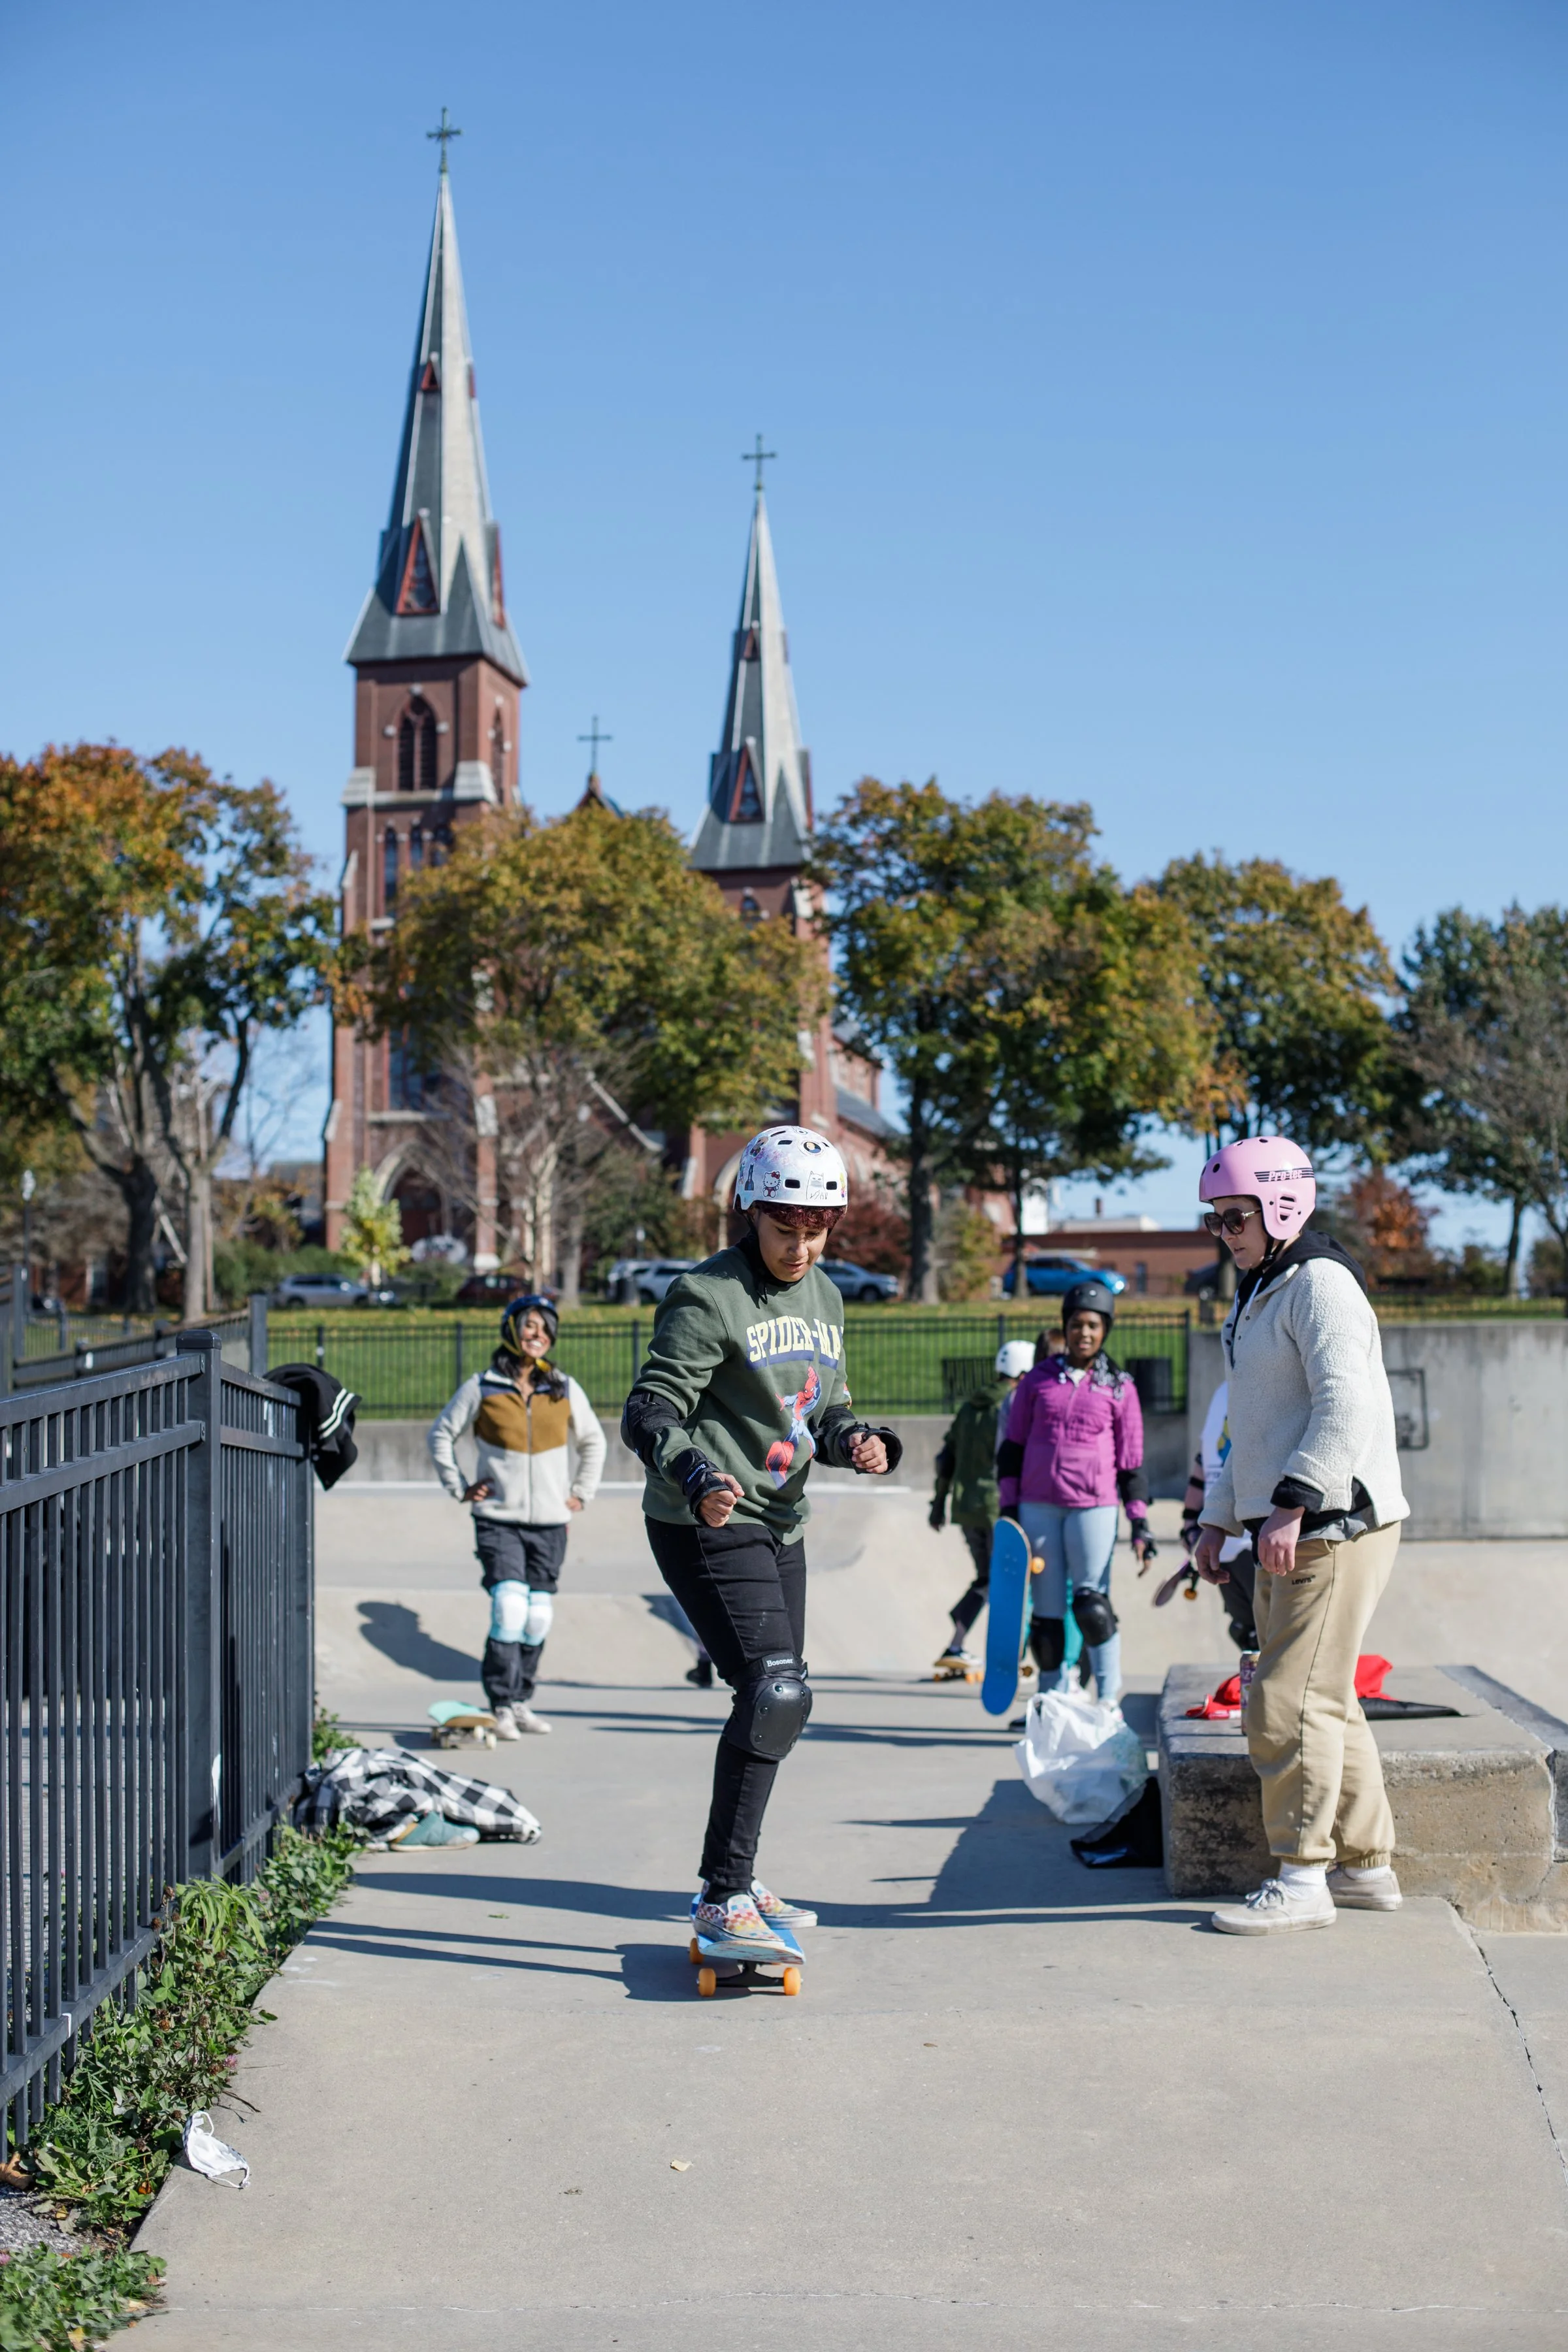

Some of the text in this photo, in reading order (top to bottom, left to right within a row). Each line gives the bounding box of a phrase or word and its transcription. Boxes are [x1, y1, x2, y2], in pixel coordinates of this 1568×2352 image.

[746, 1315, 844, 1364] SPIDER-MA
[687, 1463, 706, 1483] Bosoner
[766, 1658, 793, 1667] Bosoner
